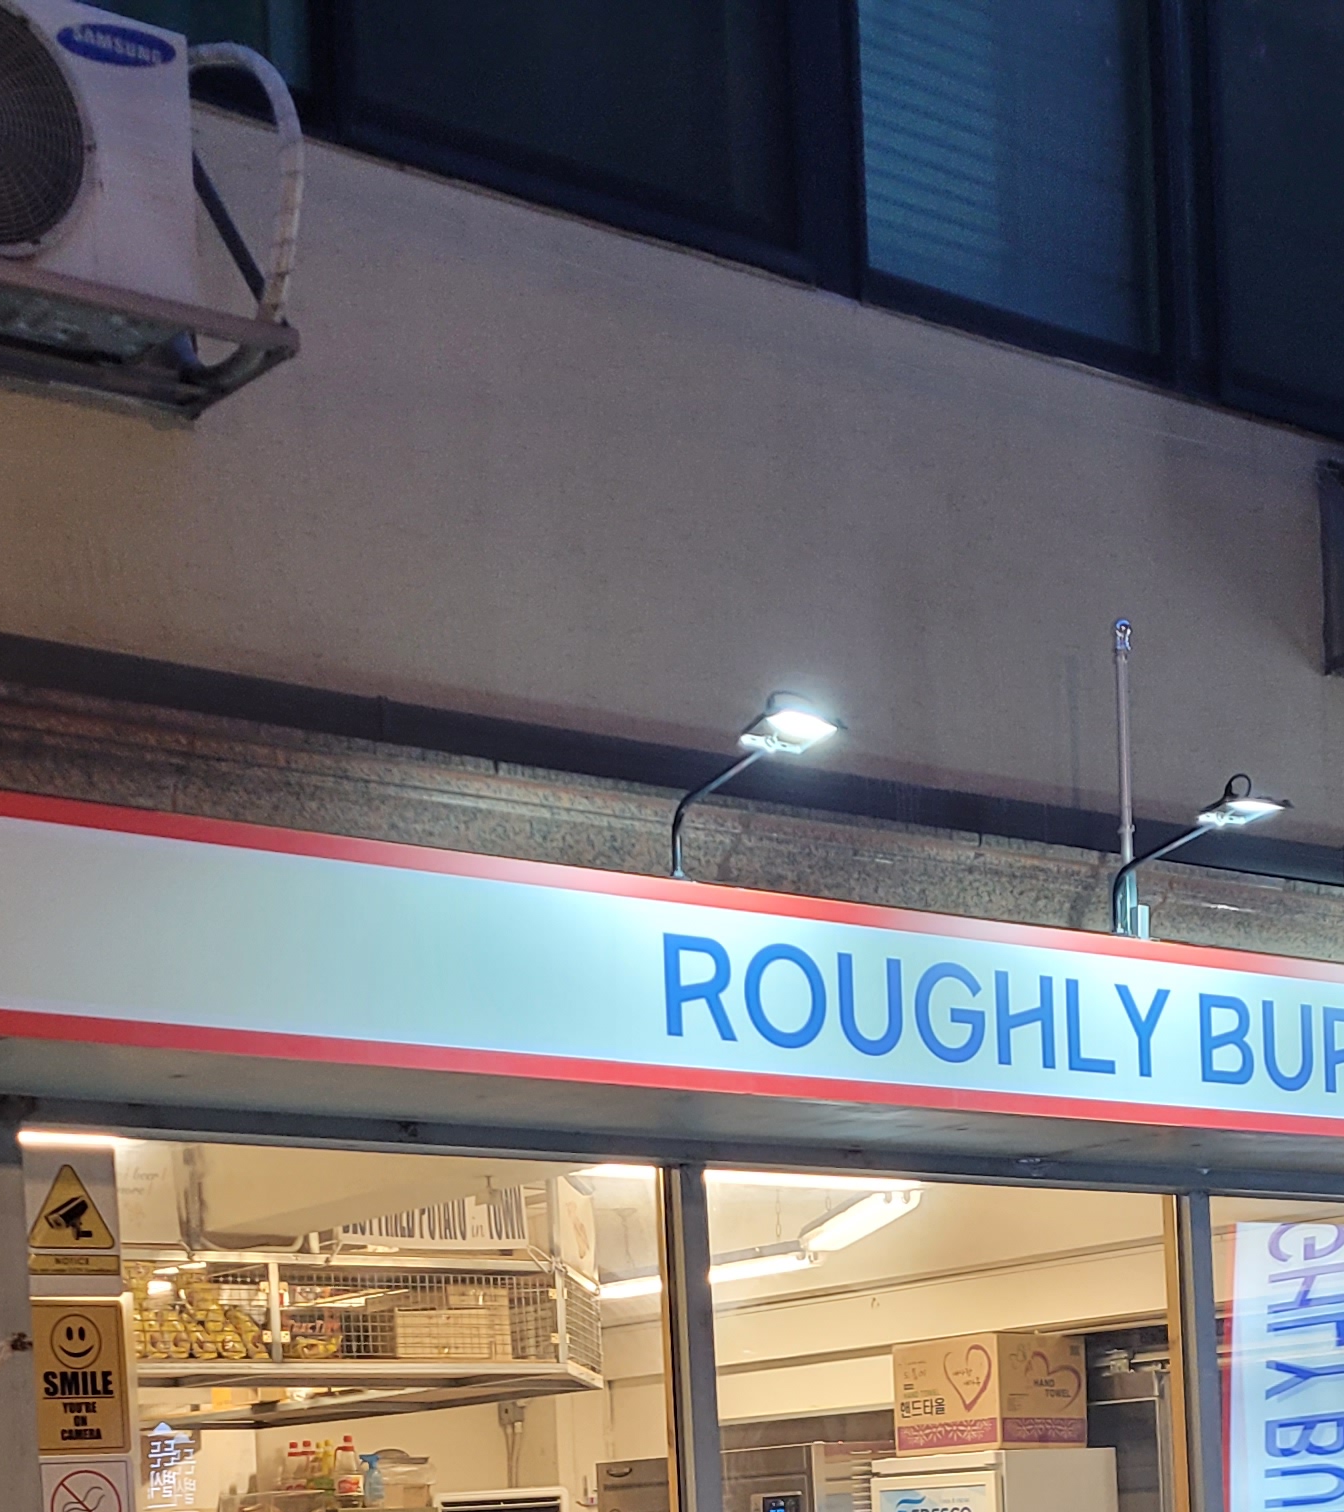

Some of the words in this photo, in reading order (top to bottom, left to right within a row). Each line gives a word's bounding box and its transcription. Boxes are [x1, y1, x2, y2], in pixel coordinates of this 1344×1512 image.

[71, 26, 163, 63] SAMSUNG
[662, 931, 1171, 1079] ROUGHLY
[43, 1370, 114, 1396] SMILE
[61, 1428, 102, 1440] CAMERA
[73, 1415, 88, 1427] ON
